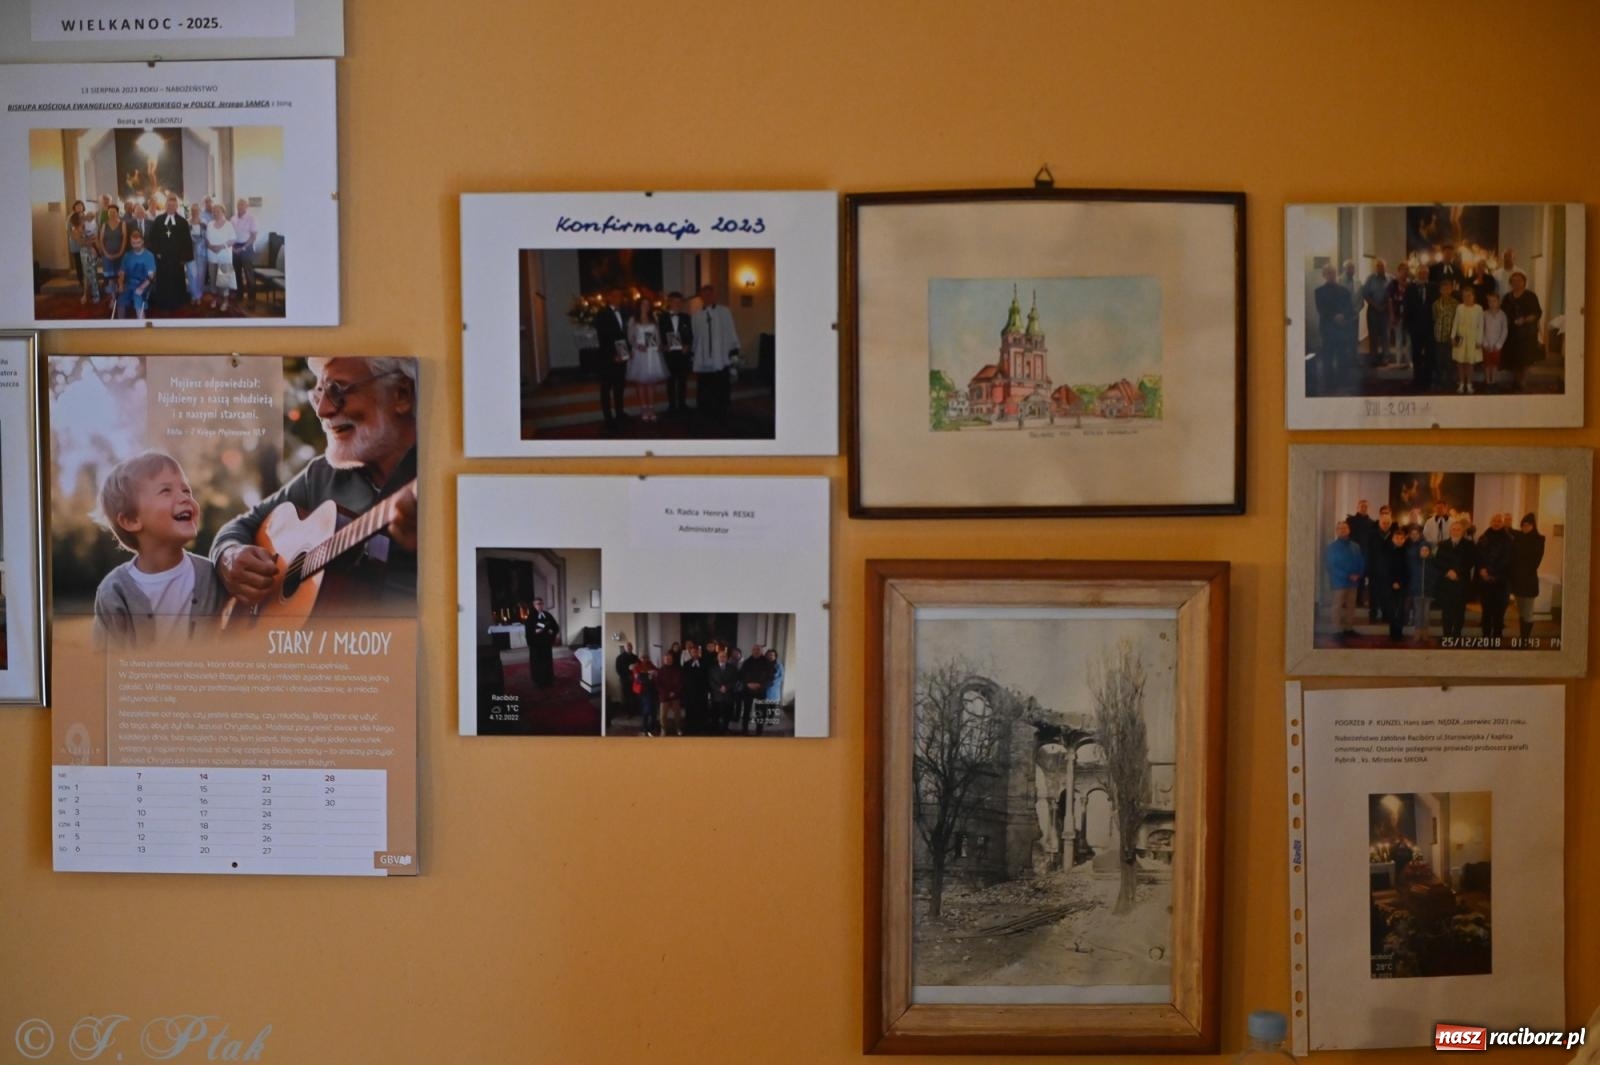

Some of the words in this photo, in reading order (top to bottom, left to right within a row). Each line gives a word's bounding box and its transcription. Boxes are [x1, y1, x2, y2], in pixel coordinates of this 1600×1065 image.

[7, 103, 37, 112] BISKUPA
[556, 216, 700, 240] Konfirmacja
[711, 216, 765, 234] 2023
[268, 630, 314, 655] STARY
[334, 631, 392, 656] MŁODY
[1441, 637, 1501, 648] 25/12/2018
[1511, 638, 1540, 648] 01:43
[325, 799, 335, 807] 30
